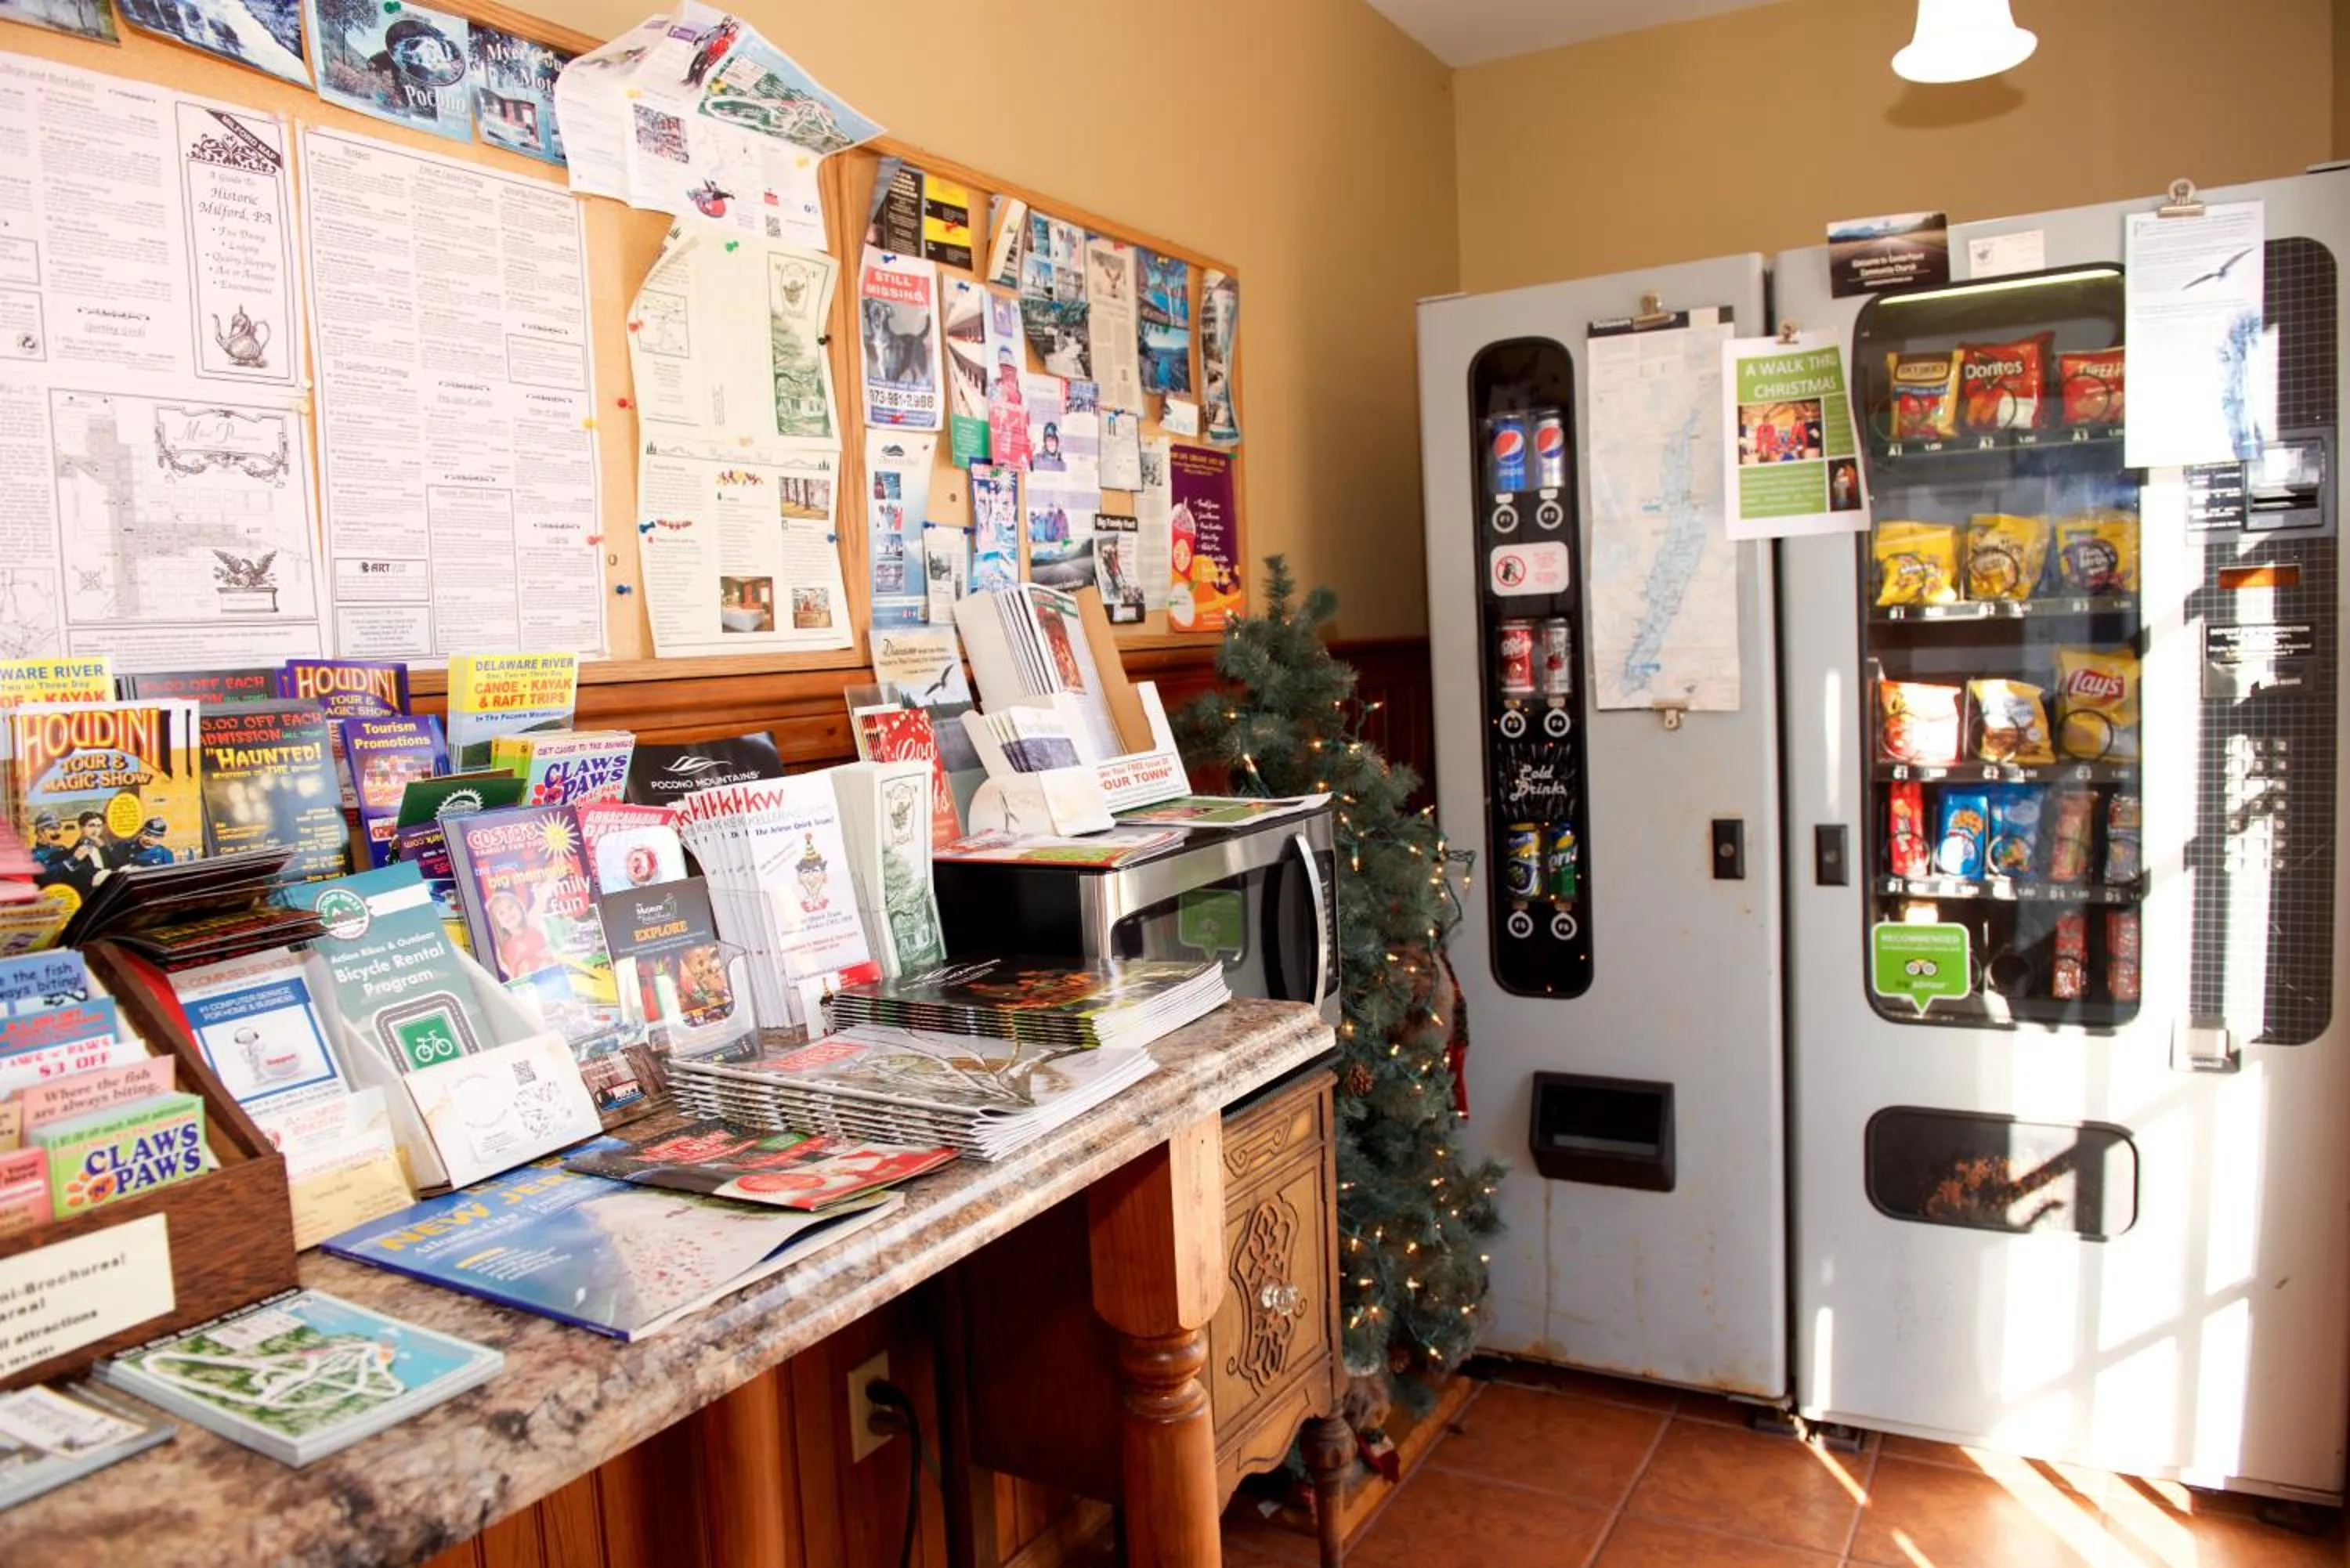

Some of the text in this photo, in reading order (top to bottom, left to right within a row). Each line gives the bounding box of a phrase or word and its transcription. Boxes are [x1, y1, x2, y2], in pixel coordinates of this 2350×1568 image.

[404, 85, 466, 112] Pocono
[209, 187, 258, 206] Historic
[197, 201, 249, 222] Milford,
[873, 271, 913, 287] STILL
[865, 283, 925, 303] MISSING
[1744, 358, 1803, 377] A WALK
[1964, 359, 2023, 380] Doritos
[1887, 443, 1903, 457] A1
[1979, 436, 1994, 450] A2
[2073, 429, 2089, 443] A3
[56, 663, 103, 678] RIVER
[475, 657, 574, 671] DELAWARE RIVER
[225, 676, 265, 690] EACH
[295, 667, 401, 711] HOUDINI
[474, 678, 573, 694] CANOE KAYAK
[45, 689, 107, 703] KAYAK
[330, 695, 365, 706] TOUR
[479, 691, 566, 709] & RAFT TRIPS
[244, 712, 323, 728] OFF EACH
[324, 706, 393, 717] AGIC SHOW
[362, 722, 418, 735] Tourism
[19, 707, 161, 779] HOUDINI
[353, 736, 431, 750] Promotions
[60, 753, 129, 775] TOUR &
[544, 754, 628, 789] CLAWS
[1517, 764, 1554, 781] Cold
[43, 771, 154, 794] MAGIC SHOW
[561, 768, 624, 807] PAWS
[651, 771, 757, 790] POCONO MOUNTAINS
[1509, 780, 1567, 801] Drinks
[632, 919, 689, 943] EXPLORE
[13, 961, 74, 984] the fish
[334, 941, 446, 985] Bicycle Rental
[362, 968, 434, 998] Program
[75, 1052, 110, 1070] OFF
[45, 1069, 151, 1104] Where the fish
[34, 1107, 56, 1120] are
[62, 1093, 109, 1114] always
[85, 1122, 200, 1176] CLAWS
[116, 1147, 201, 1194] PAWS
[378, 1201, 492, 1252] NEW
[16, 1310, 98, 1344] attractions
